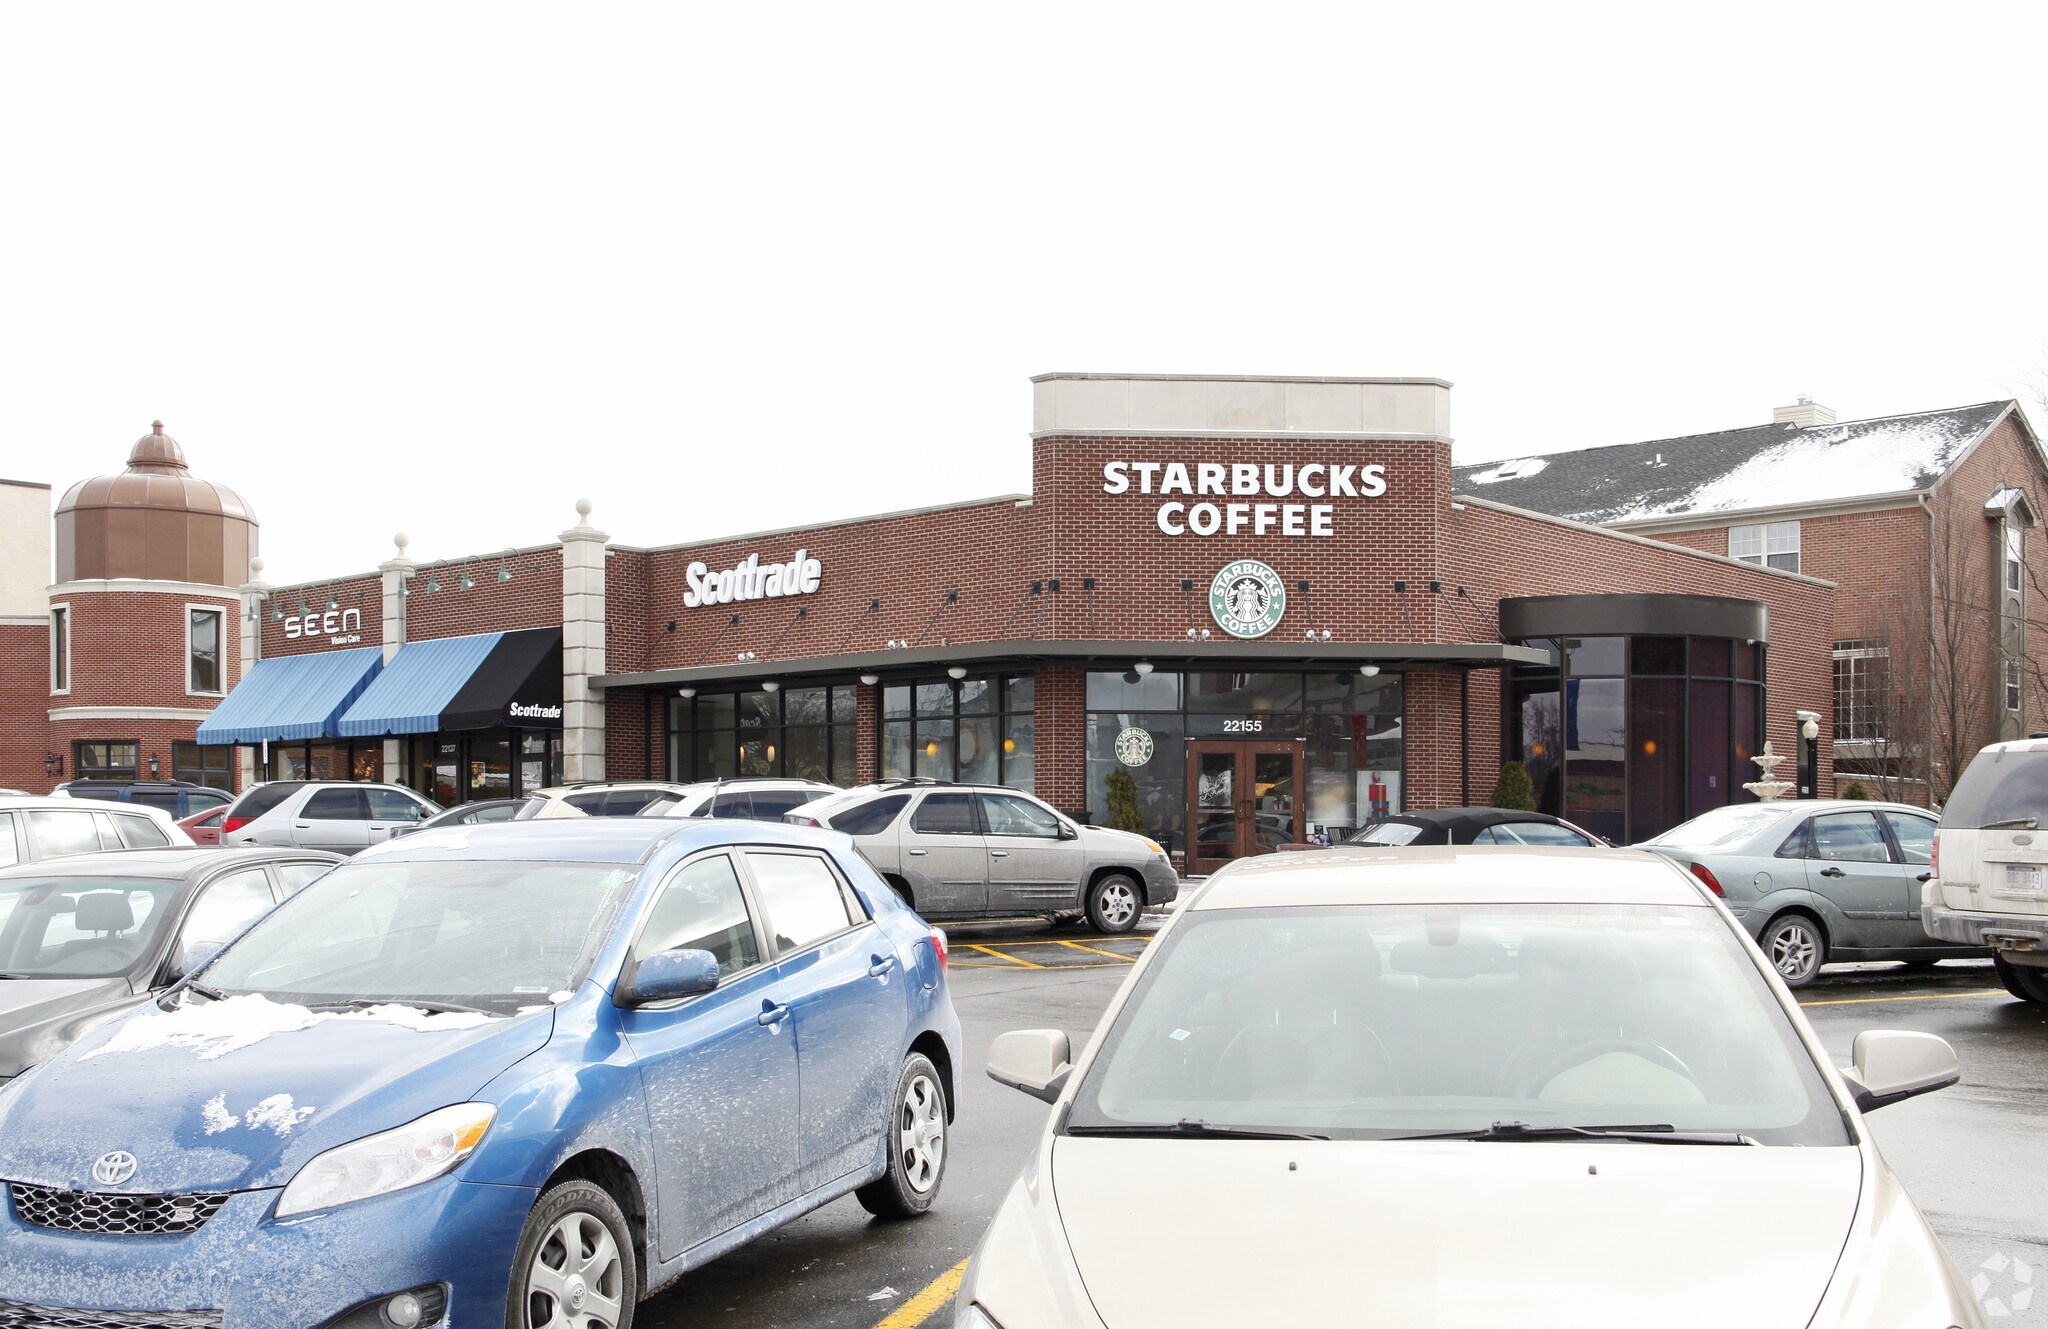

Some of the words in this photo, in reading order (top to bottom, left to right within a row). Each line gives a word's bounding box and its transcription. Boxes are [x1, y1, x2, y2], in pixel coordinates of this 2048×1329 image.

[1103, 461, 1387, 497] STARBUCKS
[1157, 501, 1334, 536] COFFEE
[683, 549, 821, 608] Scottrade
[1213, 563, 1282, 597] STARBUCKS
[1221, 613, 1275, 634] COFFEE
[331, 636, 347, 645] Vision
[347, 635, 361, 643] Care
[510, 702, 562, 719] Scottrade
[1223, 719, 1262, 732] 22155
[1117, 729, 1152, 747] STARBUCKS
[1120, 754, 1148, 765] COFFEE
